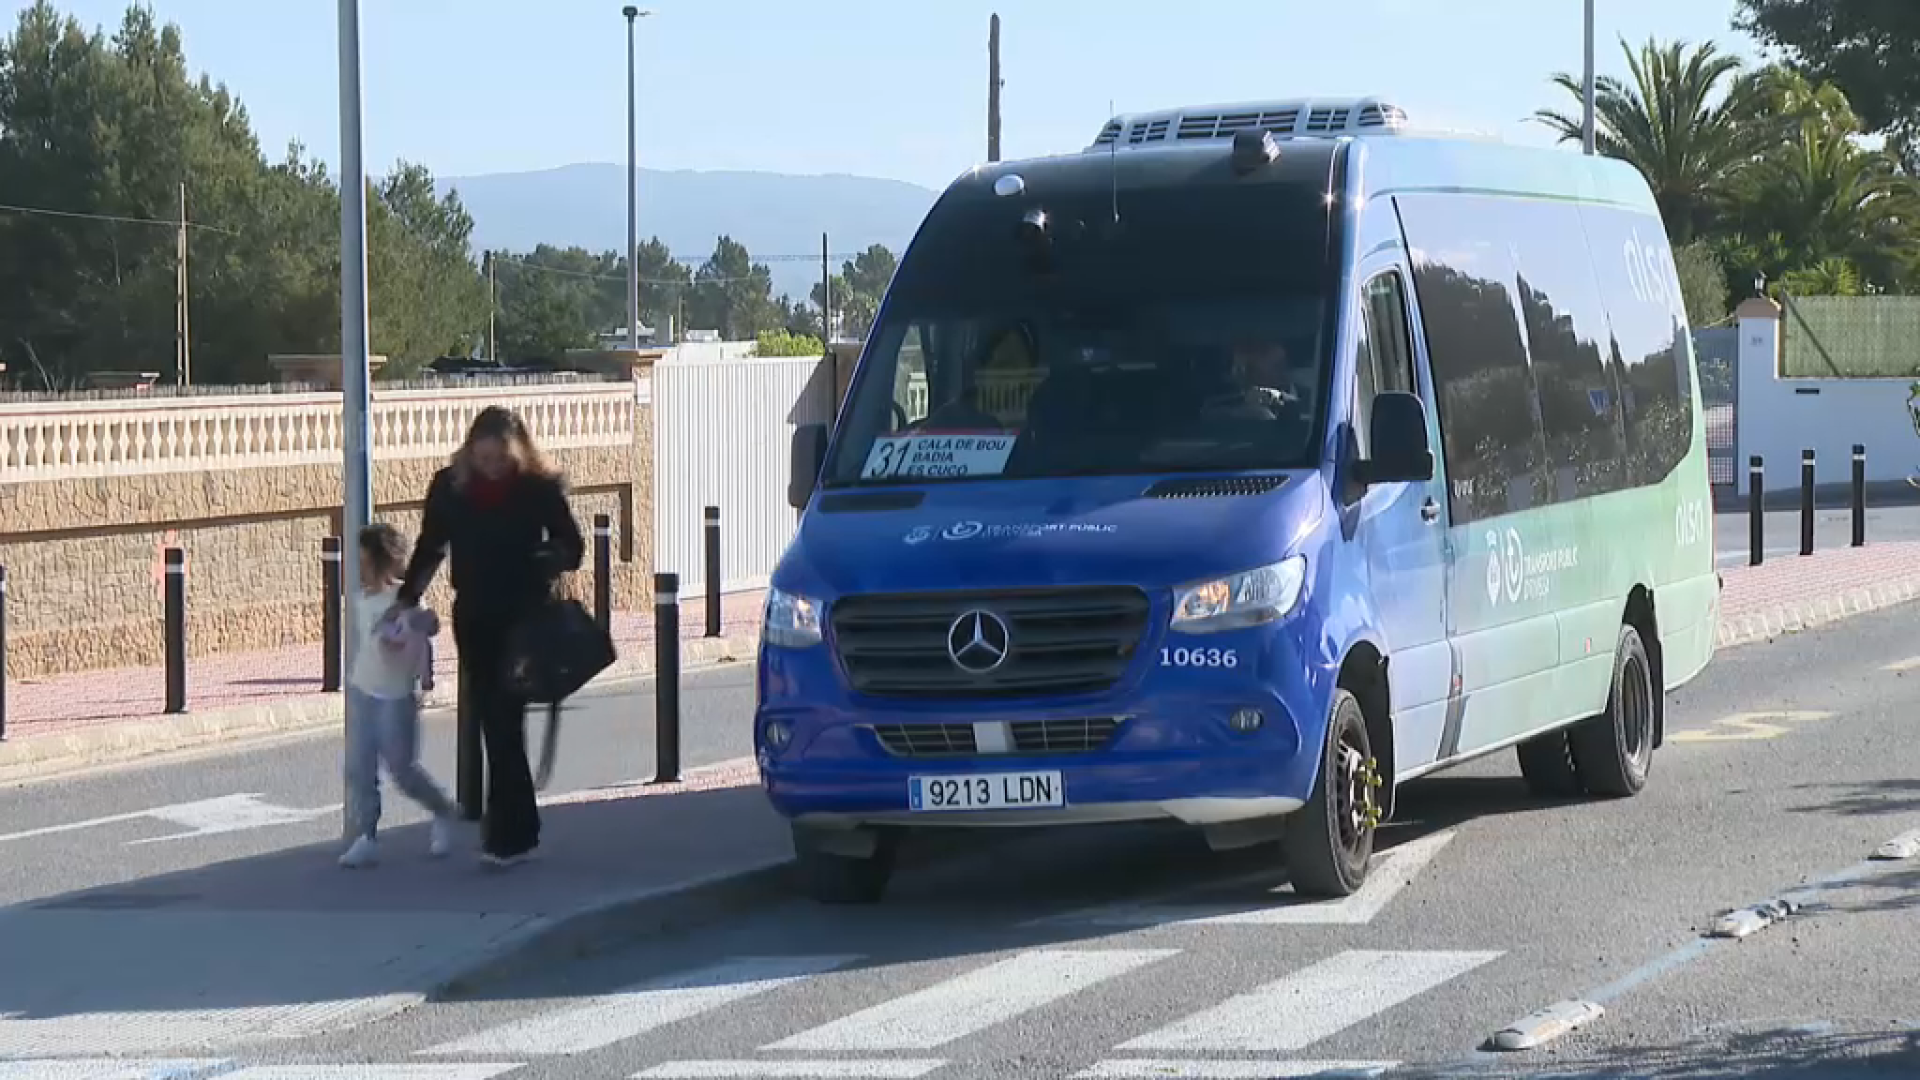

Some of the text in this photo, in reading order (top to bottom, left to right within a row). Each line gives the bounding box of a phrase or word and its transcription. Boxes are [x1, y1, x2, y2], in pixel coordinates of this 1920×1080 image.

[918, 439, 1008, 451] CALA DE BOU
[871, 439, 912, 477] 31
[907, 464, 925, 476] ES
[1159, 647, 1238, 668] 10636
[928, 778, 991, 806] 9213
[1003, 775, 1052, 804] LDN
